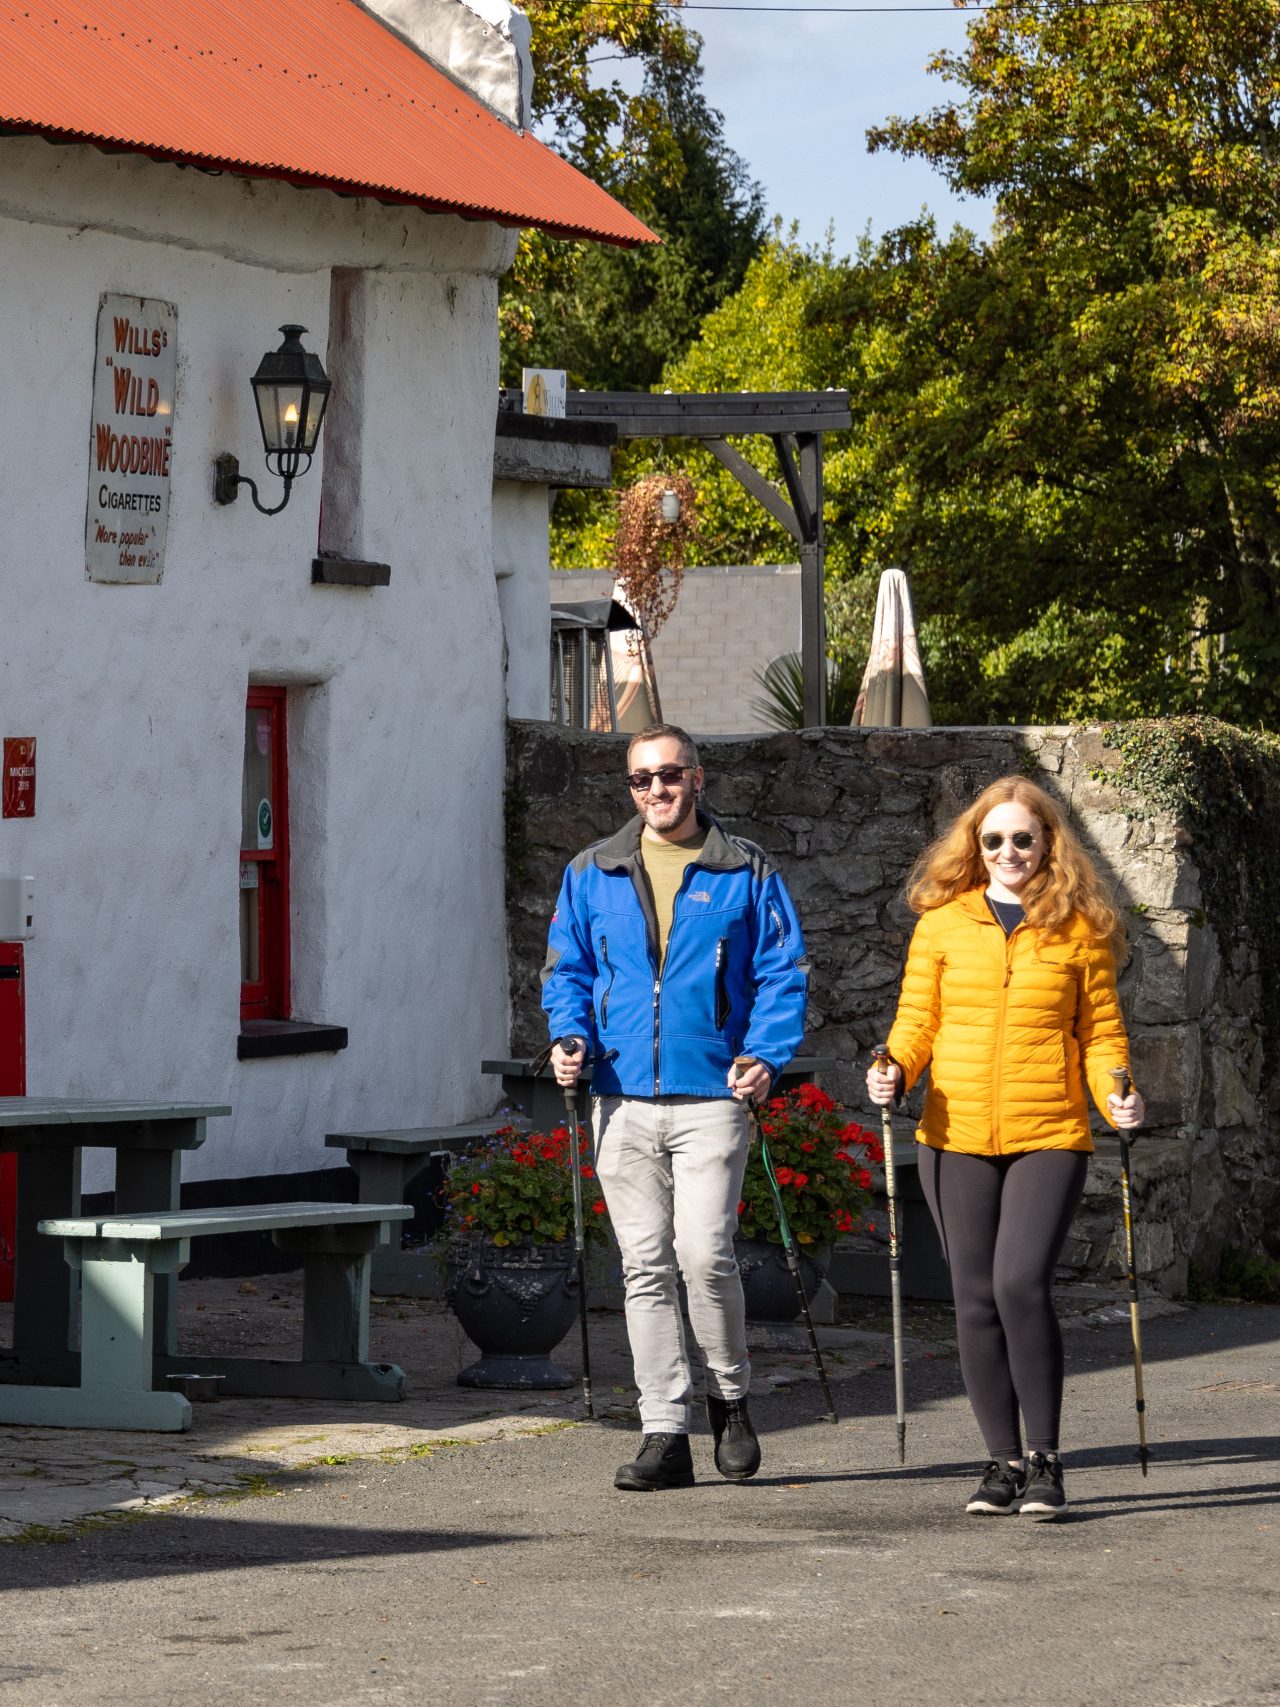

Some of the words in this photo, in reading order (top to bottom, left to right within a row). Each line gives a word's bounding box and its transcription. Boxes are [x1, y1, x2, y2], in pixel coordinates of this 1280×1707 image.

[98, 484, 161, 512] CIGARETTES
[118, 527, 149, 549] popular
[119, 549, 136, 566] than
[10, 767, 35, 777] MICHELIN
